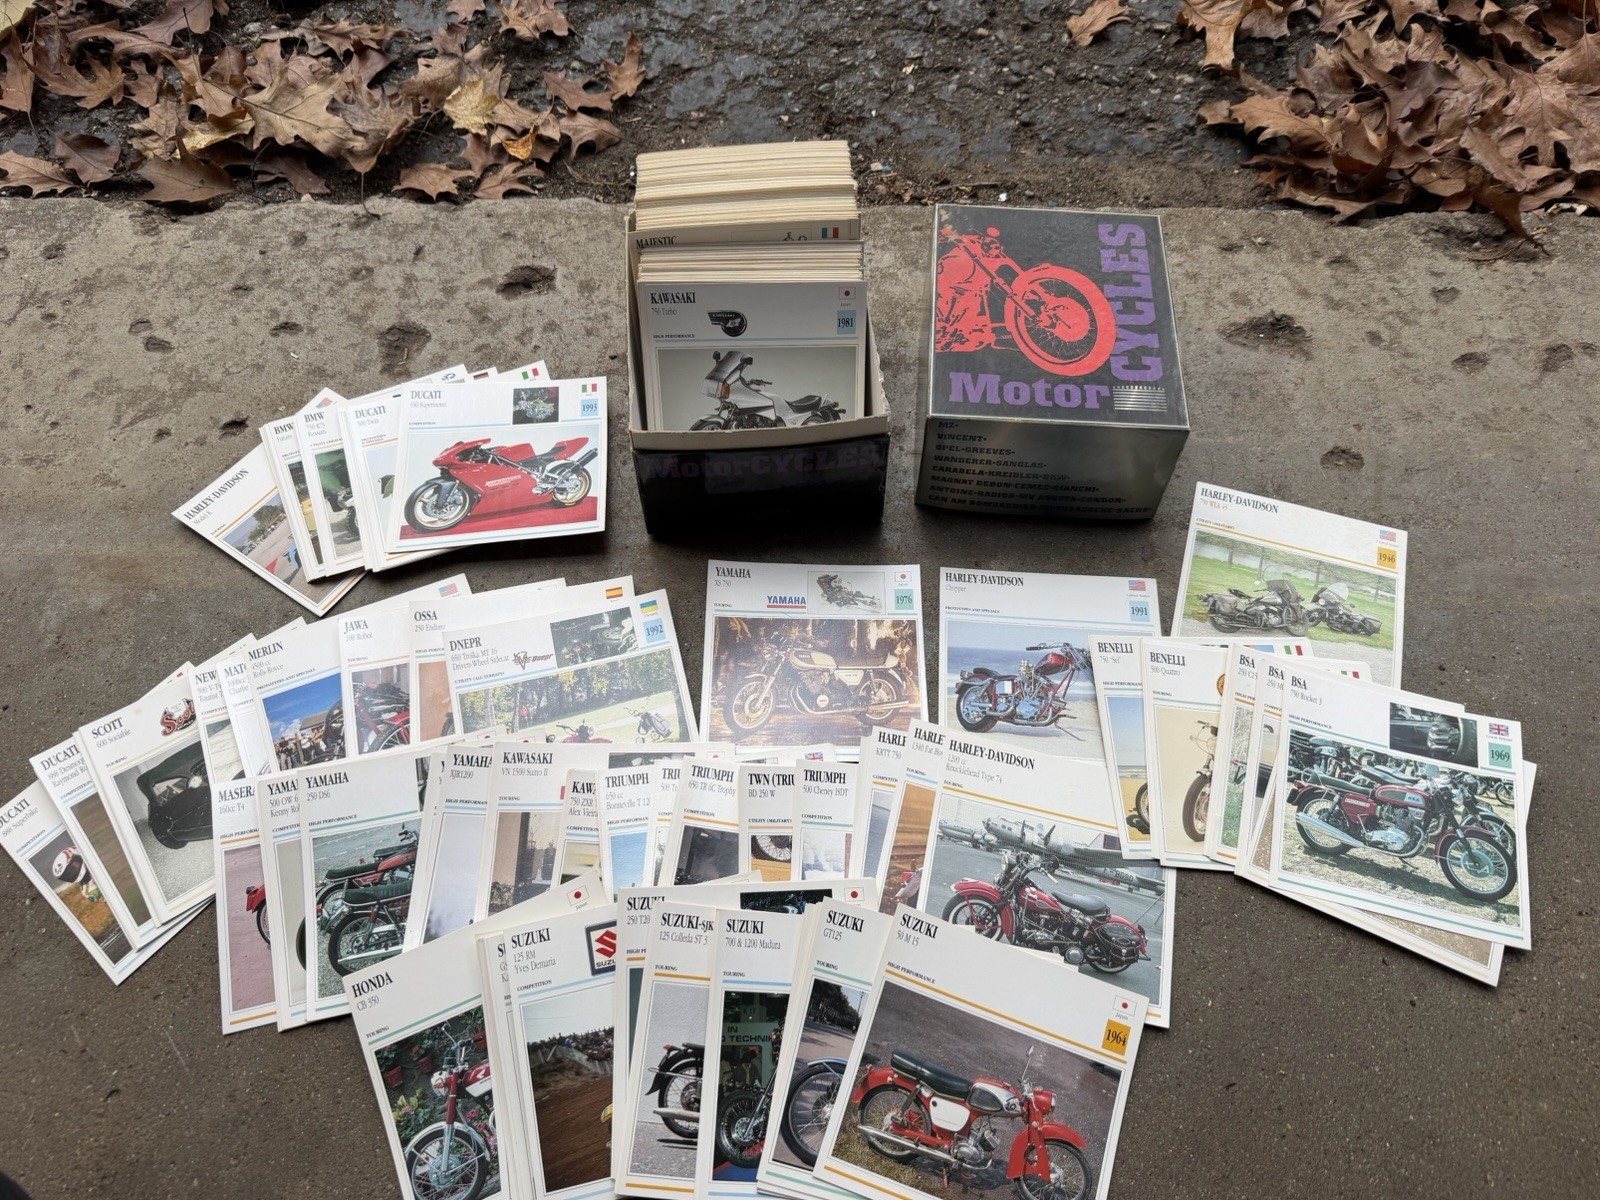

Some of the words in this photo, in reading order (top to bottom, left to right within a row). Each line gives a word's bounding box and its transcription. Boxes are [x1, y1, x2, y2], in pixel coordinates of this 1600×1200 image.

[650, 292, 696, 304] KAWASAKI
[1098, 222, 1163, 382] CYCLES
[837, 317, 854, 328] 1981
[410, 390, 442, 400] DUCATI
[949, 371, 1111, 409] Motor
[354, 405, 387, 419] DUCATI
[582, 404, 598, 412] 1993
[304, 411, 325, 423] BMW
[274, 422, 294, 435] BMW
[183, 468, 249, 520] HARLEY-DAVIDSON
[1200, 487, 1279, 514] HARLEY-DAVIDSON
[1378, 552, 1397, 563] 1946
[714, 566, 751, 579] YAMAHA
[945, 572, 1024, 587] HARLEY-DAVIDSON
[767, 595, 807, 605] YAMAHA
[895, 595, 913, 605] 1976
[414, 610, 438, 621] OSSA
[1130, 606, 1149, 616] 1991
[343, 619, 369, 635] JAWA
[645, 623, 664, 637] 1992
[449, 636, 482, 651] DNEPR
[1097, 642, 1134, 654] BENELLI
[248, 641, 283, 661] MERLIN
[1150, 652, 1187, 667] BENELLI
[1239, 654, 1255, 669] BSA
[195, 670, 218, 685] NEW
[1268, 665, 1285, 681] BSA
[1291, 675, 1308, 691] BSA
[1300, 692, 1317, 704] Rocket
[91, 717, 123, 740] SCOTT
[40, 744, 80, 771] DUCATI
[502, 752, 553, 765] KAWASAKI
[949, 739, 1036, 773] HARLEY-DAVIDSON
[1490, 749, 1510, 762] 1969
[501, 768, 511, 776] VN
[512, 768, 526, 776] 1500
[526, 768, 543, 776] Sumo
[691, 765, 735, 782] TRIUMPH
[803, 769, 847, 785] TRIUMPH
[945, 764, 981, 781] Knucklehead
[305, 771, 350, 789] YAMAHA
[605, 773, 650, 788] TRIUMPH
[748, 773, 770, 786] TWN
[307, 791, 318, 802] 250
[318, 790, 331, 800] DS6
[717, 785, 737, 797] Trophy
[759, 789, 769, 798] 250
[802, 784, 813, 794] 500
[269, 796, 281, 808] 500
[270, 806, 289, 818] Kenny
[568, 807, 582, 817] Alex
[660, 911, 715, 932] SUZUKI-SJK
[725, 918, 765, 935] SUZUKI
[826, 909, 865, 933] SUZUKI
[899, 912, 939, 939] SUZUKI
[511, 927, 551, 950] SUZUKI
[659, 930, 670, 941] 125
[671, 931, 693, 943] Colleda
[693, 934, 703, 944] ST
[823, 927, 843, 941] GT125
[895, 929, 904, 941] 50
[904, 933, 912, 944] M
[725, 936, 736, 948] 700
[736, 938, 744, 948] &
[744, 938, 758, 949] 1200
[758, 938, 782, 950] Madura
[513, 951, 525, 963] 125
[525, 949, 536, 960] RM
[514, 961, 530, 975] Yves
[530, 956, 557, 971] Demaria
[816, 959, 839, 970] TOURING
[900, 966, 937, 984] PERFORMANCE
[351, 971, 394, 998] HONDA
[516, 979, 552, 992] COMPETITION
[356, 1000, 368, 1011] CB
[366, 1025, 390, 1039] TOURING
[1105, 1028, 1128, 1047] 1964
